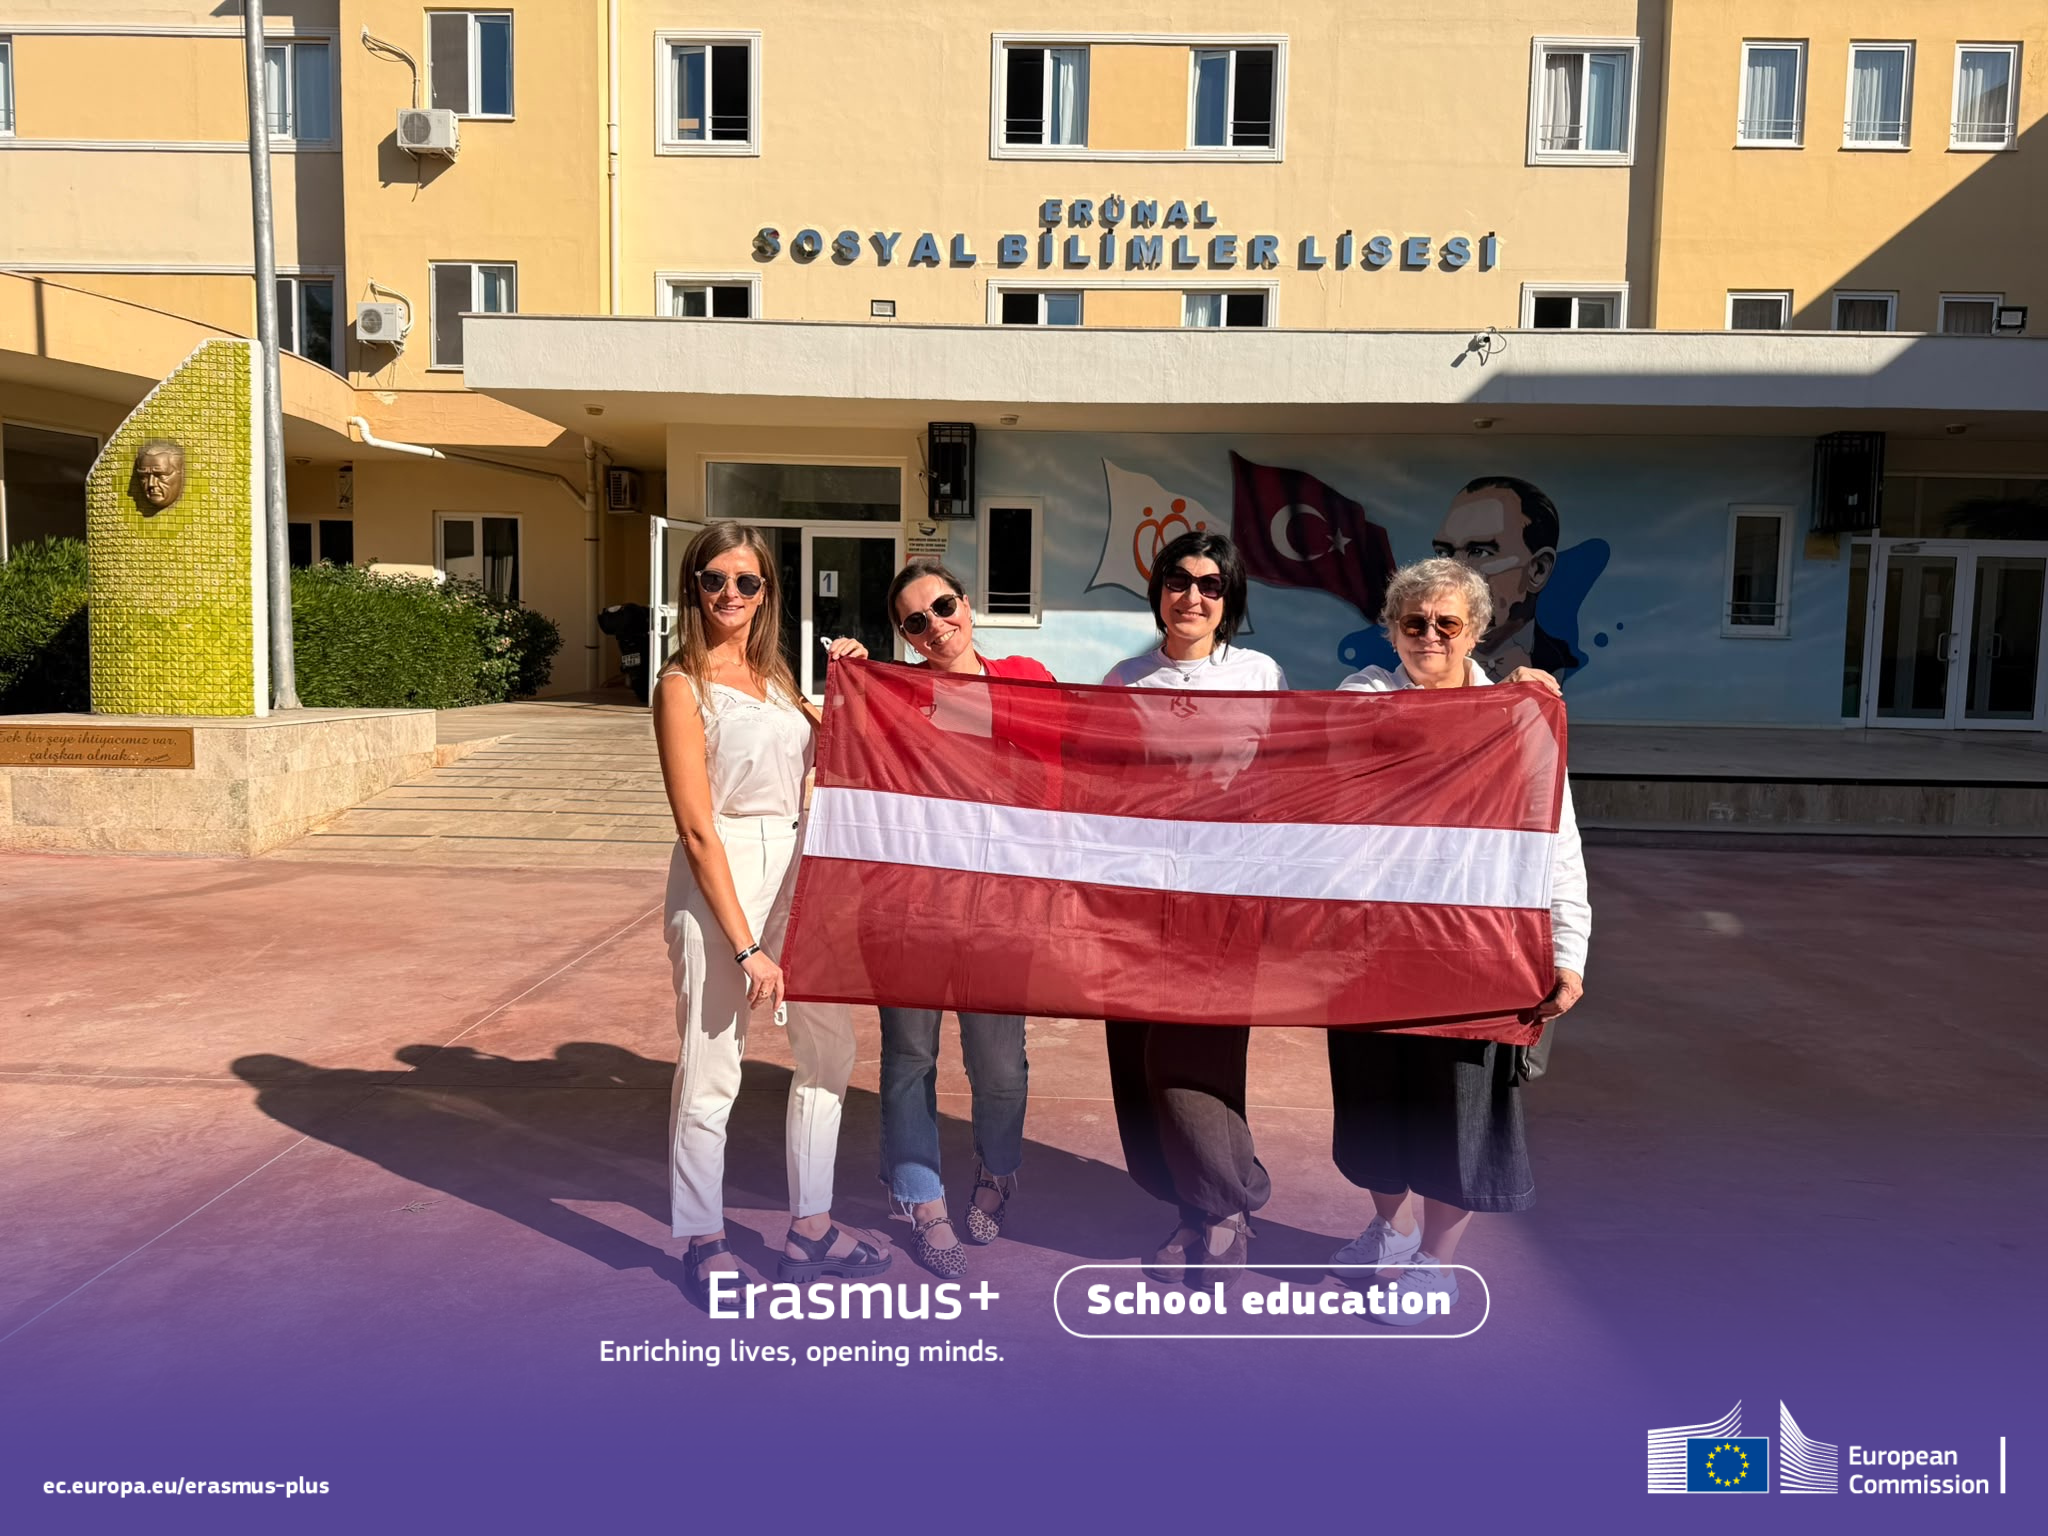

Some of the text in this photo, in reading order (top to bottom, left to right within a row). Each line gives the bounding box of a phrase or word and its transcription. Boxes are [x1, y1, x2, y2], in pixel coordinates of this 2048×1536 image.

[1042, 193, 1218, 224] ERÜNAL
[752, 227, 1497, 267] SOSYAL BİLİMLER LİSESİ
[823, 572, 832, 593] 1
[25, 731, 43, 743] bir
[46, 735, 74, 747] şeye
[78, 731, 149, 748] ihtiyacımız
[29, 747, 83, 762] çalışkan
[86, 747, 139, 761] olmak...
